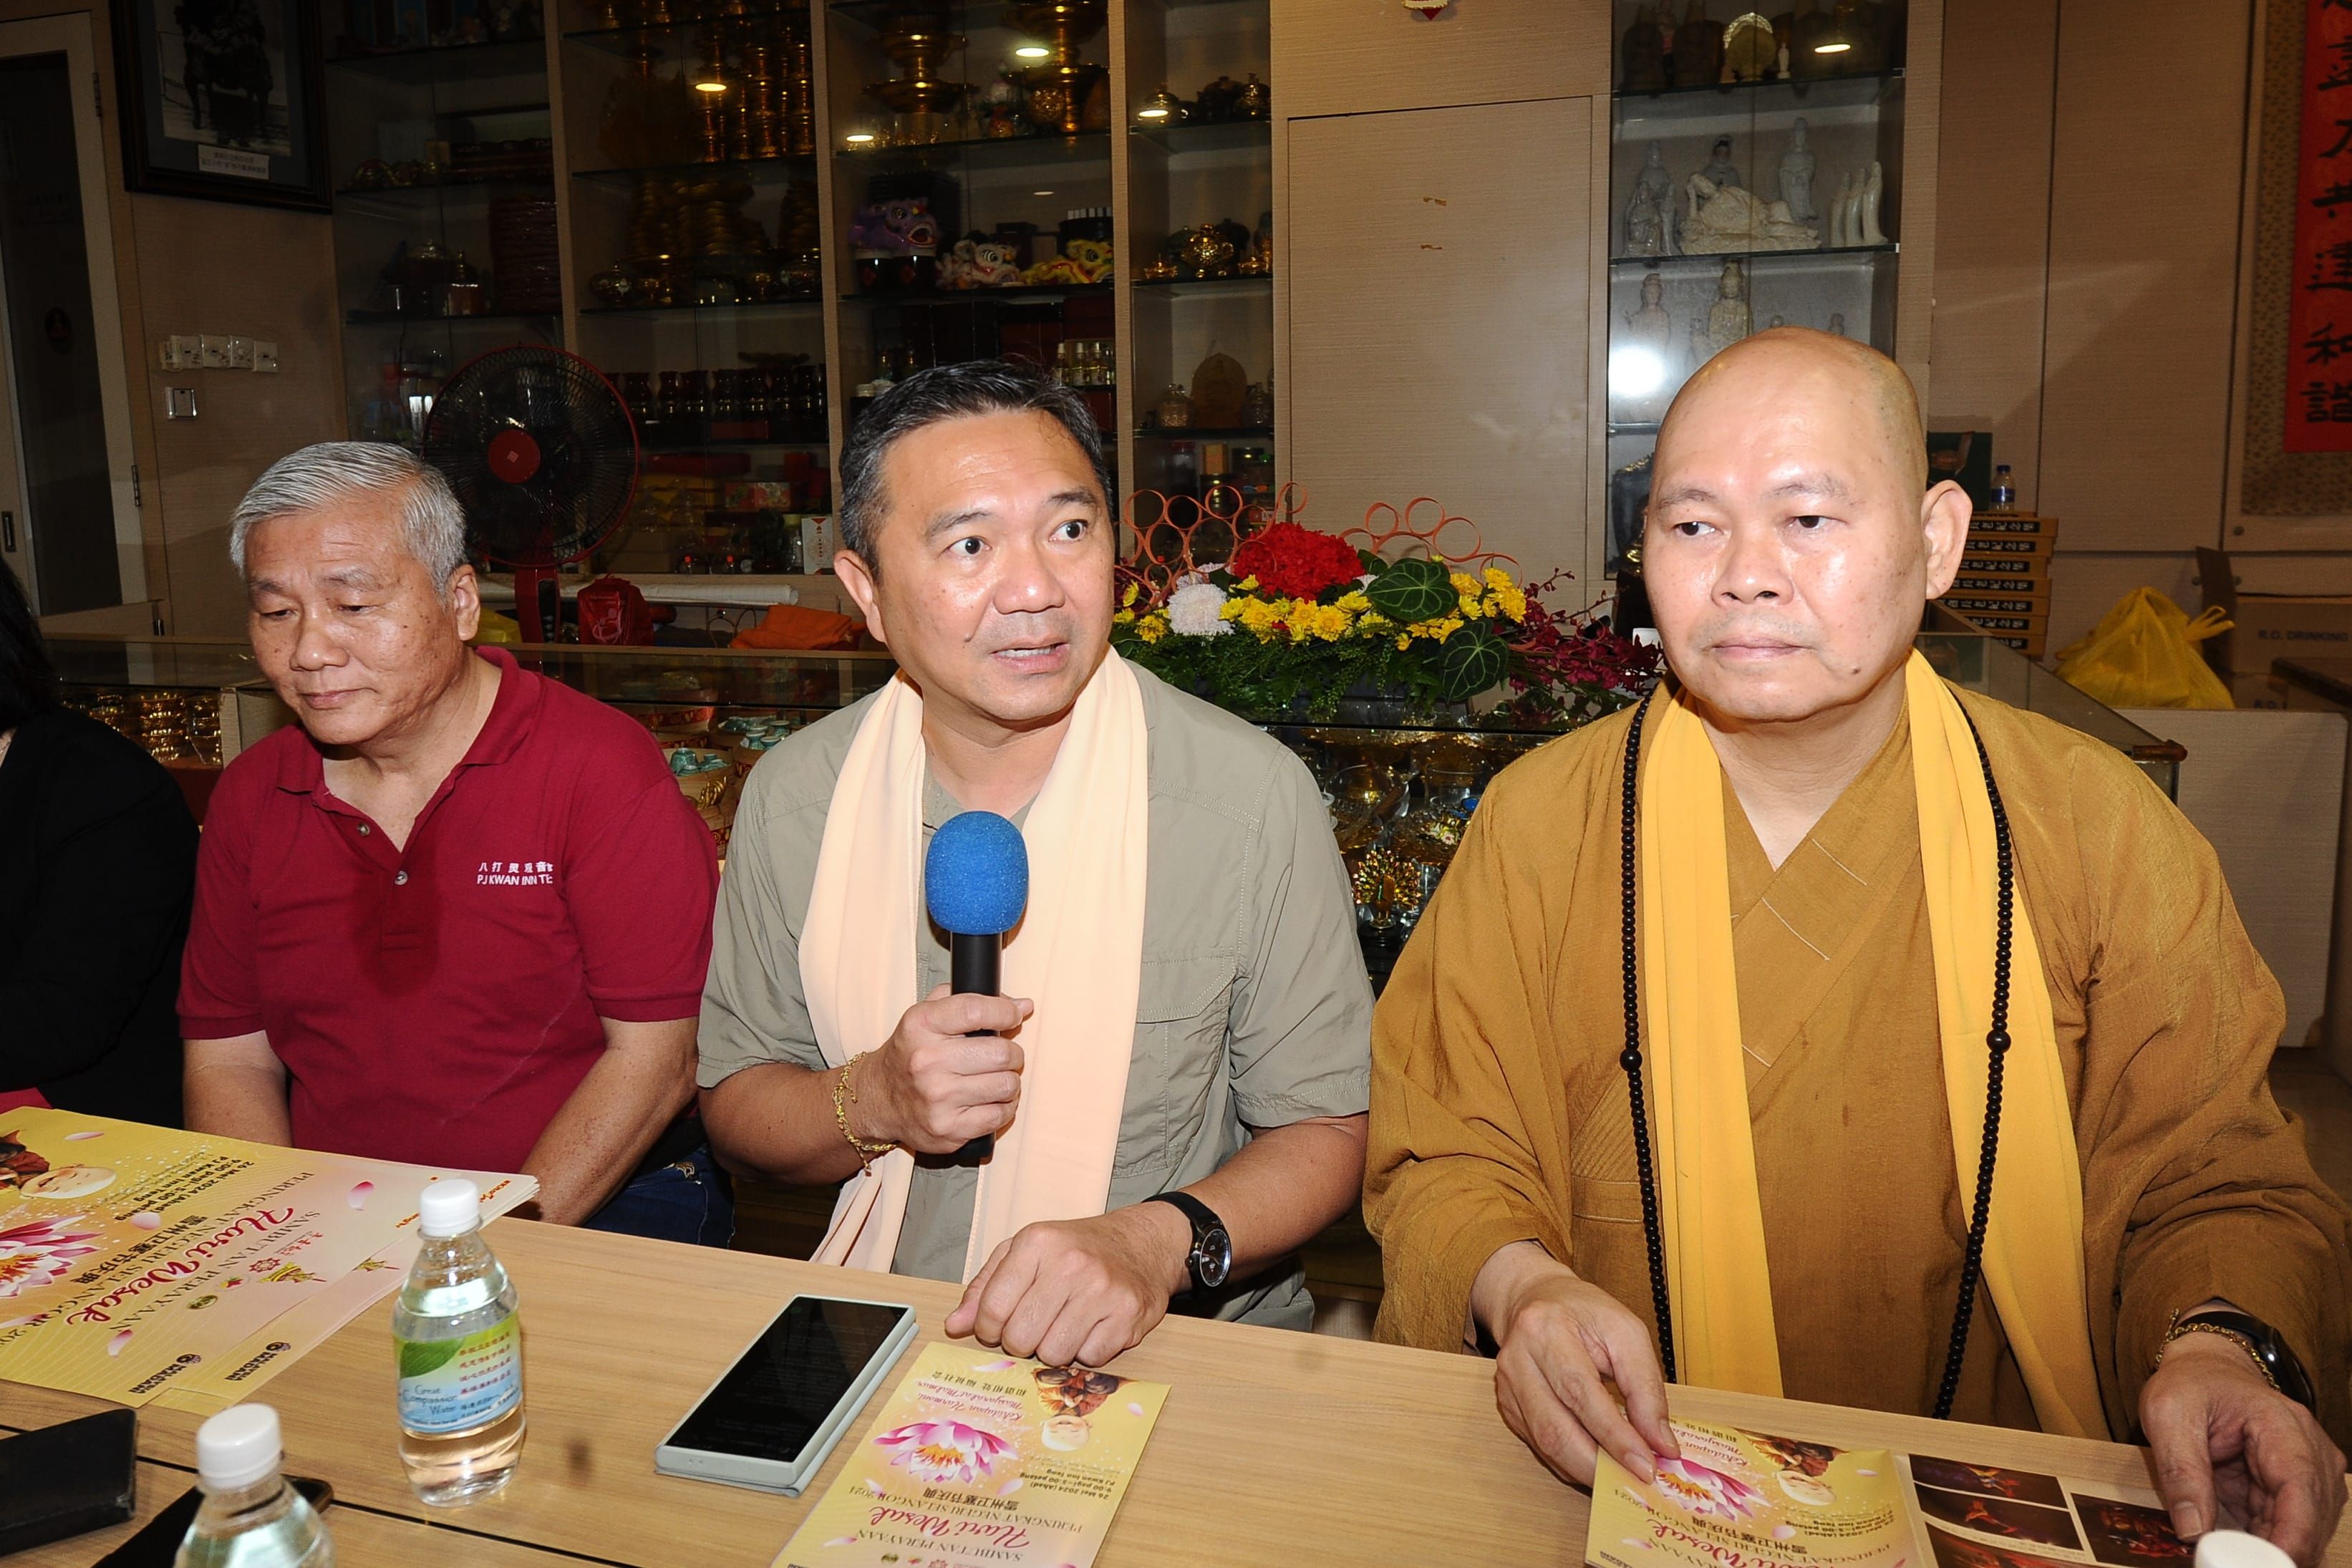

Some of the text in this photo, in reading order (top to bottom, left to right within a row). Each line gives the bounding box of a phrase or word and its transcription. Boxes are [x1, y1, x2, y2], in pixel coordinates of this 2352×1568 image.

[2287, 630, 2349, 642] DRINKING
[477, 875, 488, 885] PJ
[489, 875, 520, 886] KWAN
[521, 876, 538, 886] INN
[180, 1163, 215, 1179] Kwan
[213, 1159, 242, 1171] 9:00
[216, 1168, 241, 1179] Mei
[131, 1189, 167, 1202] Teng
[187, 1179, 220, 1194] 2024
[148, 1194, 192, 1214] (Ahad)
[211, 1171, 316, 1225] PERINGKAT
[112, 1199, 159, 1221] petang
[180, 1206, 300, 1259] Hari
[215, 1211, 322, 1269] SAMBUTAN
[68, 1214, 209, 1284] 雪州卫塞节庆典
[138, 1226, 217, 1264] NEGERI
[23, 1264, 145, 1327] SELANGOR
[61, 1259, 205, 1327] Wesak
[107, 1269, 222, 1332] PERAYAAN
[224, 1351, 271, 1380] MADANI
[127, 1363, 181, 1393] MADANI
[402, 1388, 458, 1407] Compassion
[415, 1384, 441, 1395] Great
[429, 1404, 456, 1415] Water
[1672, 1428, 1743, 1456] Masyaraka
[1018, 1471, 1048, 1481] petang
[1029, 1481, 1058, 1491] (Ahad)
[1080, 1475, 1104, 1484] Kwan
[921, 1486, 1020, 1511] 雪州卫塞节庆典
[1057, 1486, 1080, 1494] 2024
[1080, 1489, 1097, 1498] Mei
[1092, 1484, 1113, 1493] 9:00
[875, 1491, 949, 1512] SELANGOR
[948, 1505, 1000, 1521] NEGERI
[1003, 1513, 1083, 1533] PERINGKAT
[865, 1505, 1033, 1550] Hari Wesak
[1692, 1516, 1808, 1554] 雪州卫塞节庆典
[856, 1529, 1022, 1562] SAMBUTAN PERAYAAN
[1645, 1519, 1748, 1568] Wesak
[1734, 1541, 1794, 1562] NEGERI
[1802, 1544, 1890, 1564] PERINGKAT
